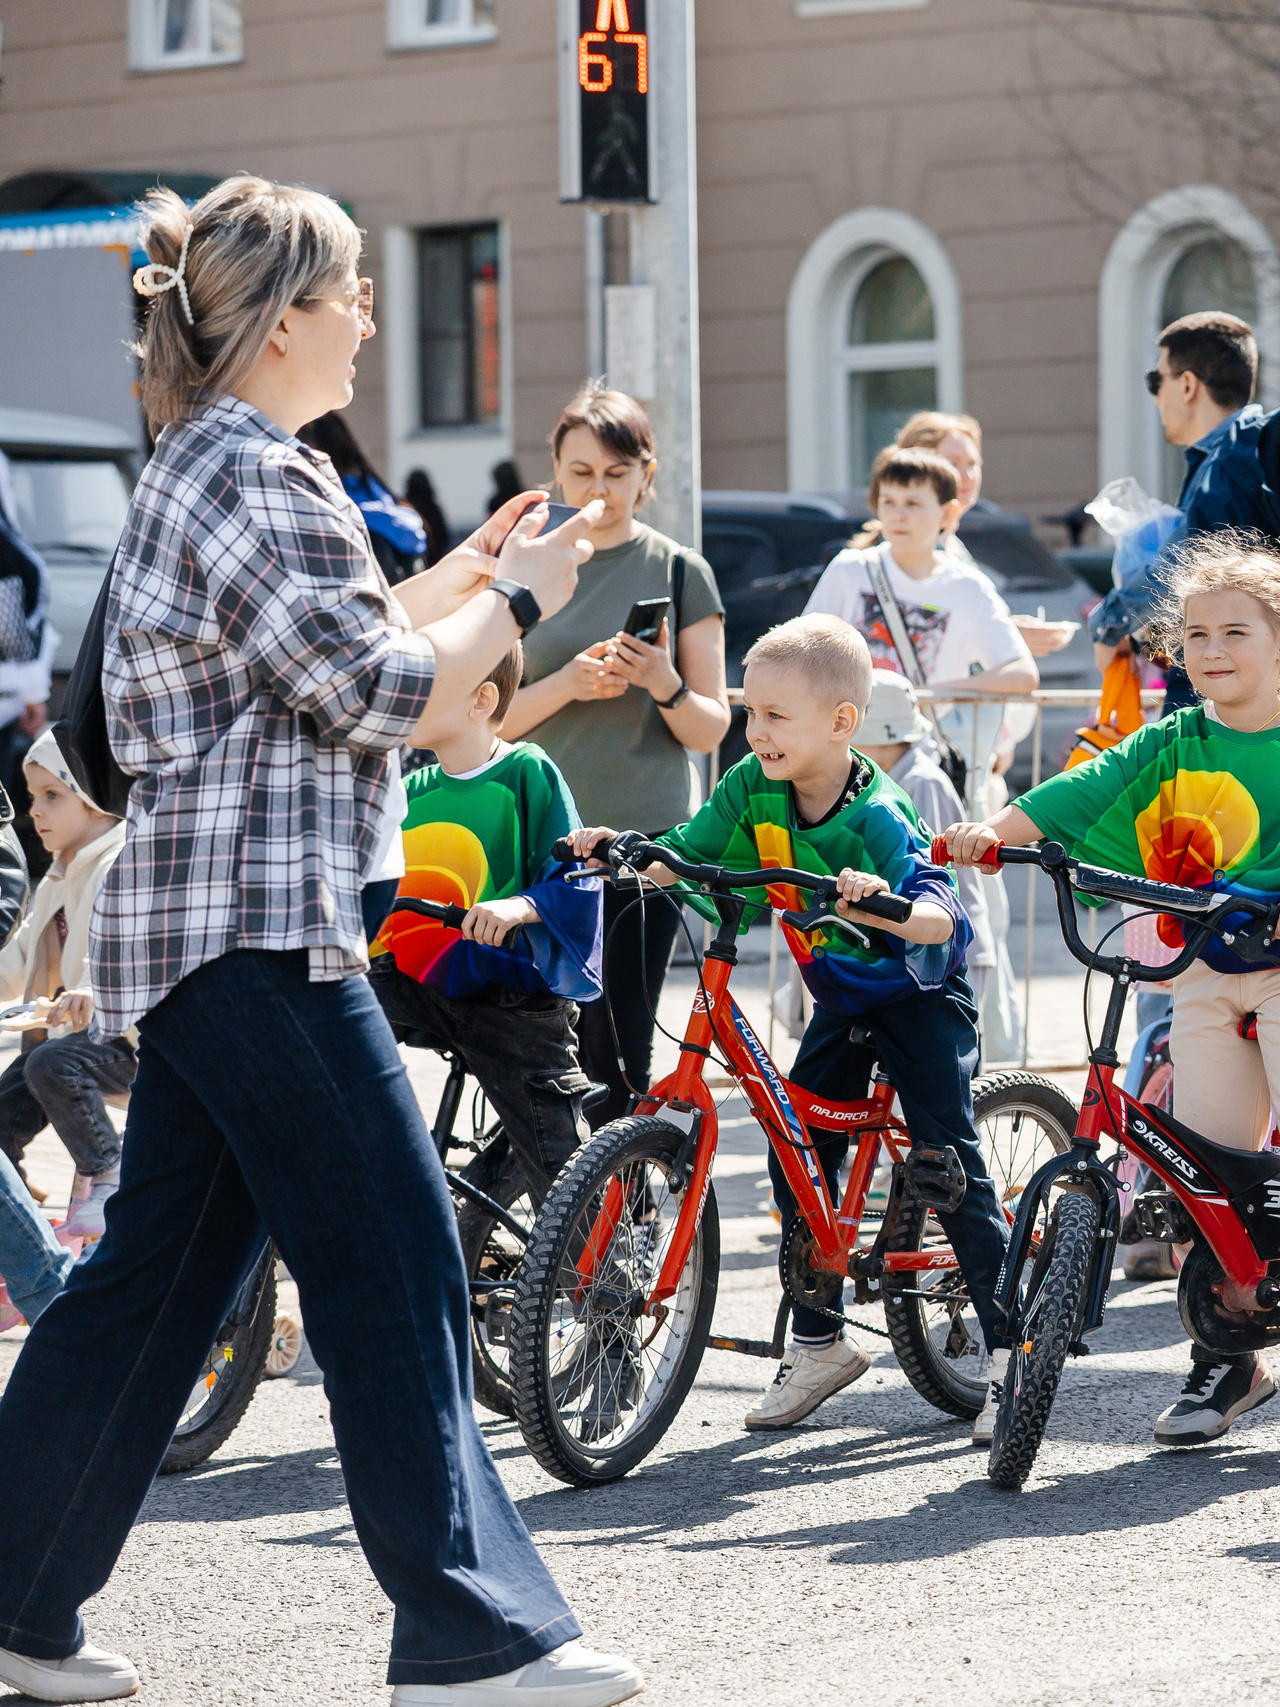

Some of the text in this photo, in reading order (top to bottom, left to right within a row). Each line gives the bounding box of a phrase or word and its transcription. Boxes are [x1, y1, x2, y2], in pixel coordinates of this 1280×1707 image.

[579, 32, 648, 94] 67
[735, 1017, 790, 1105] FORWARD
[809, 1103, 869, 1121] MAJORCA
[1143, 1130, 1199, 1180] KREISS
